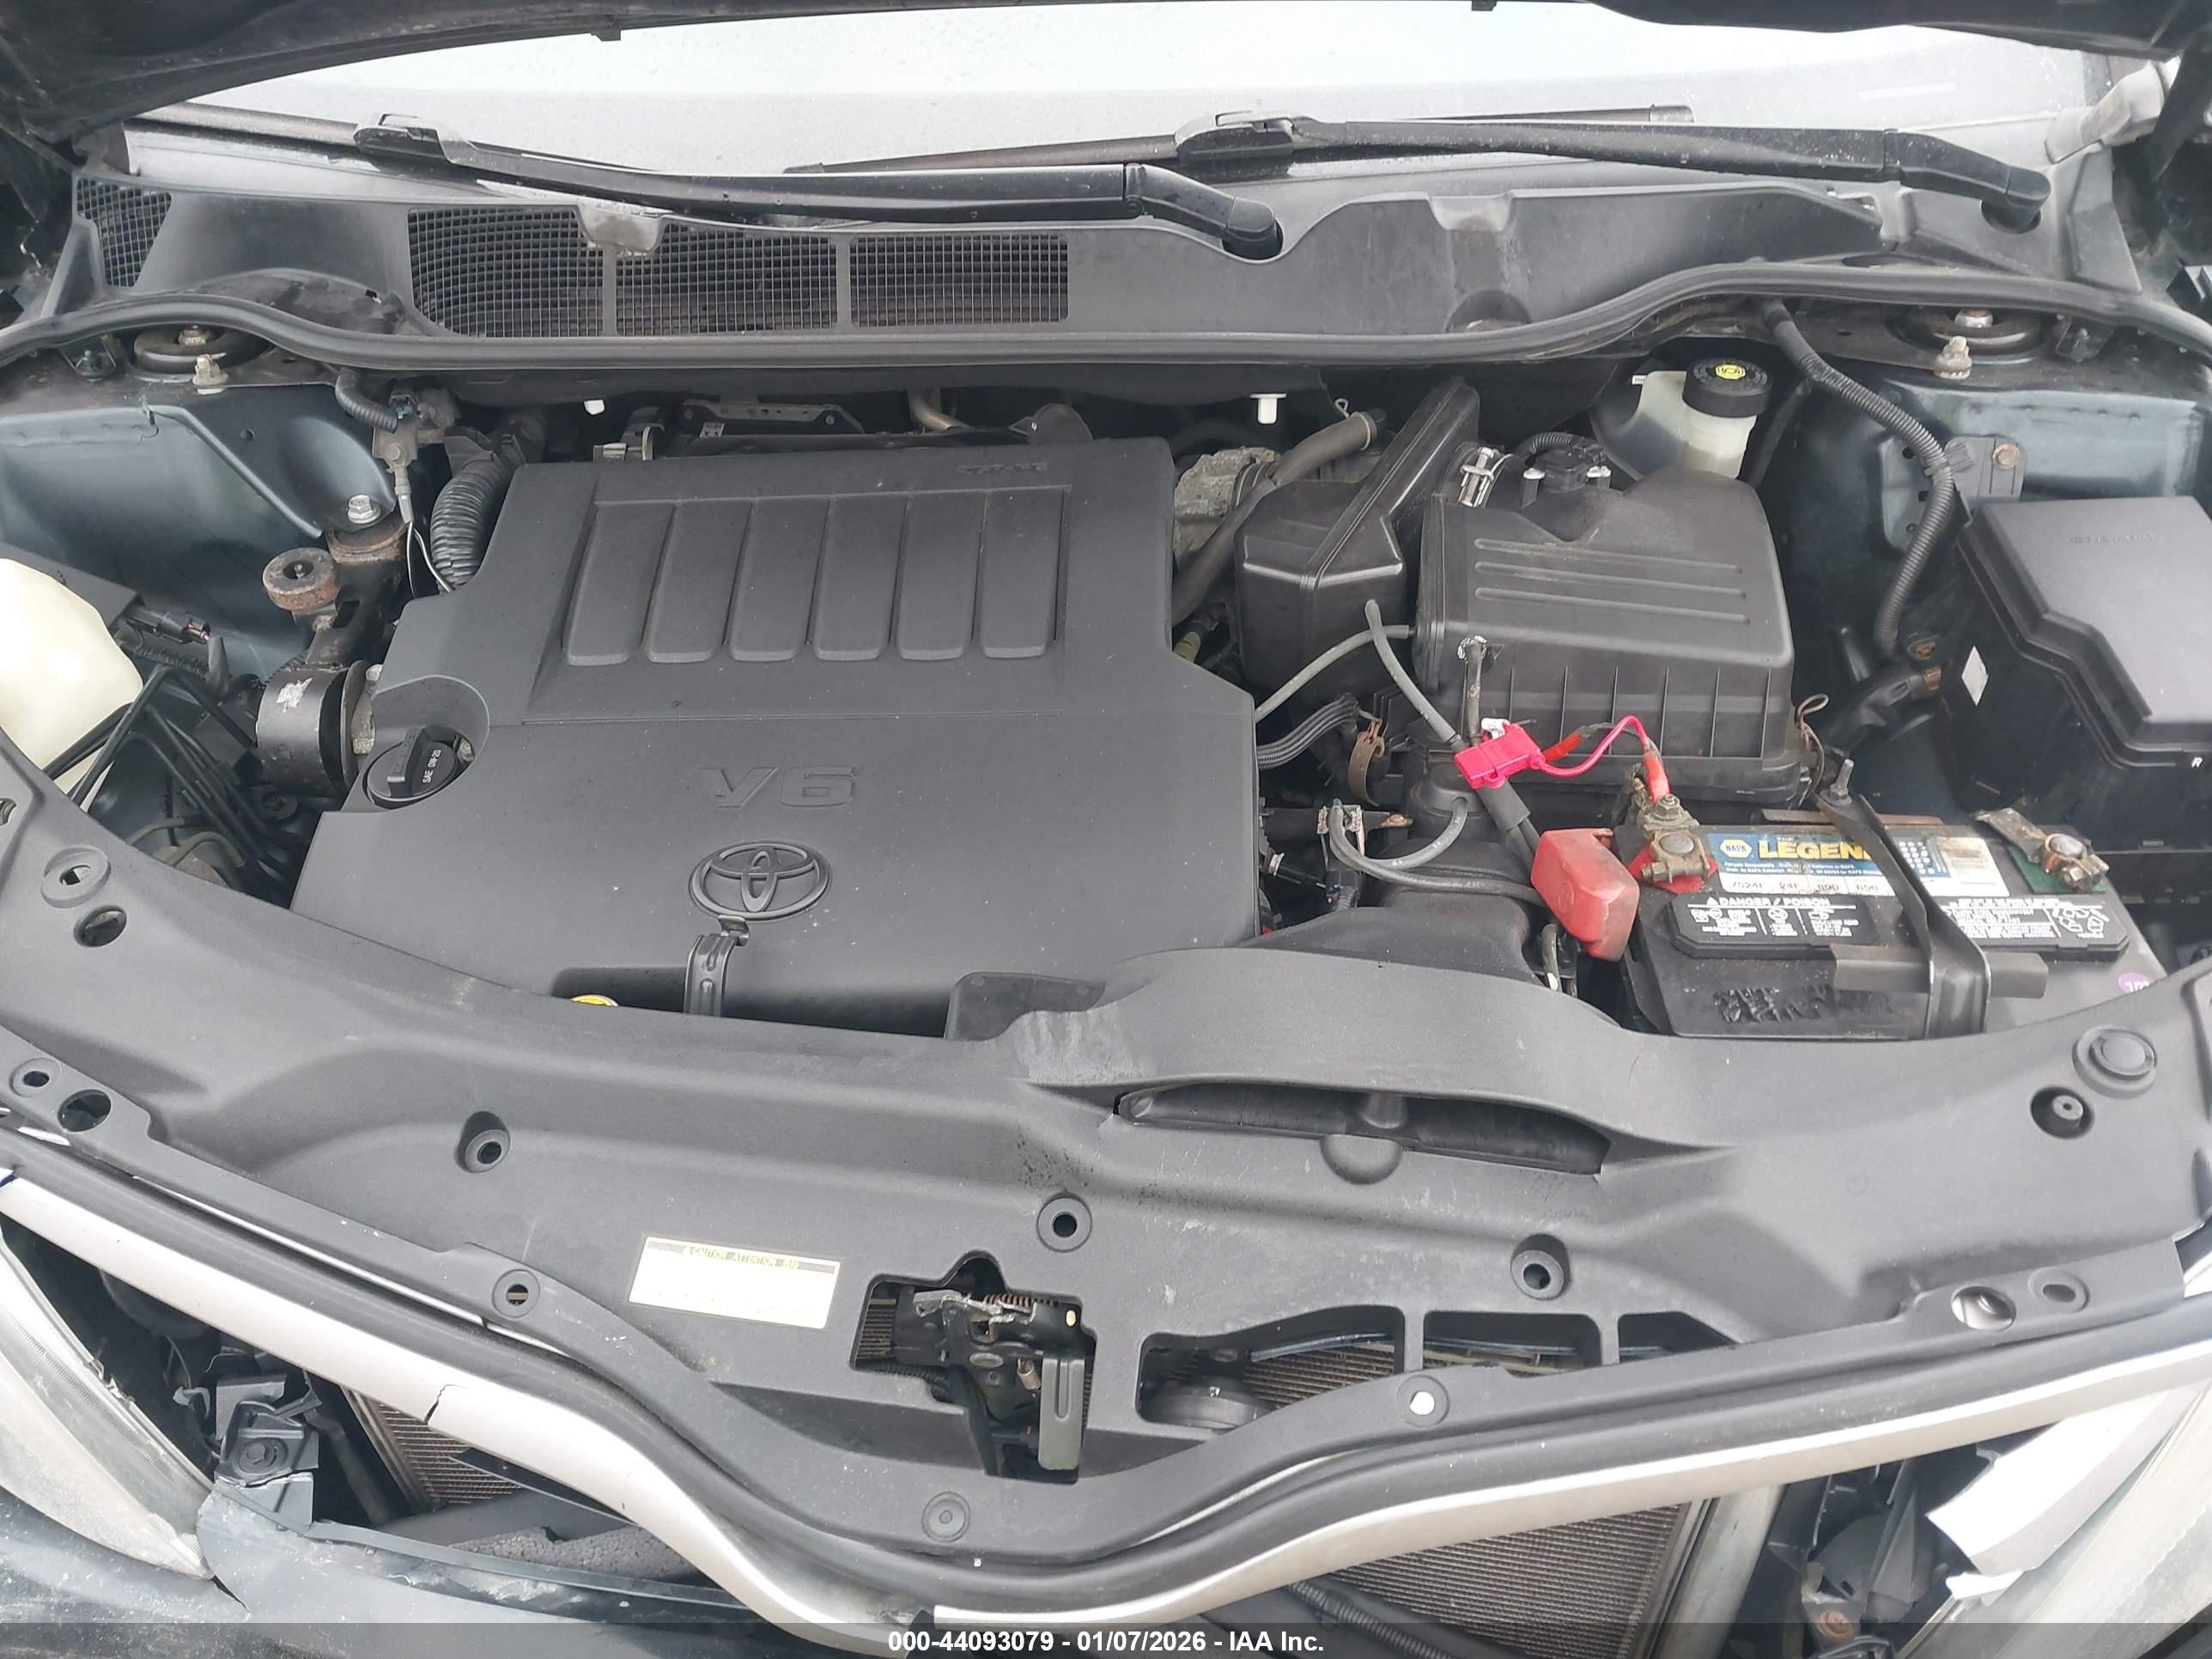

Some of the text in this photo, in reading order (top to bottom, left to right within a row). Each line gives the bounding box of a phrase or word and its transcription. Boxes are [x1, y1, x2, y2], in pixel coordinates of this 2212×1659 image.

[422, 769, 434, 783] SAE
[697, 765, 857, 808] V6
[1758, 840, 1873, 860] LEGEN
[1718, 896, 1771, 907] DANGER
[1782, 896, 1832, 908] POISON
